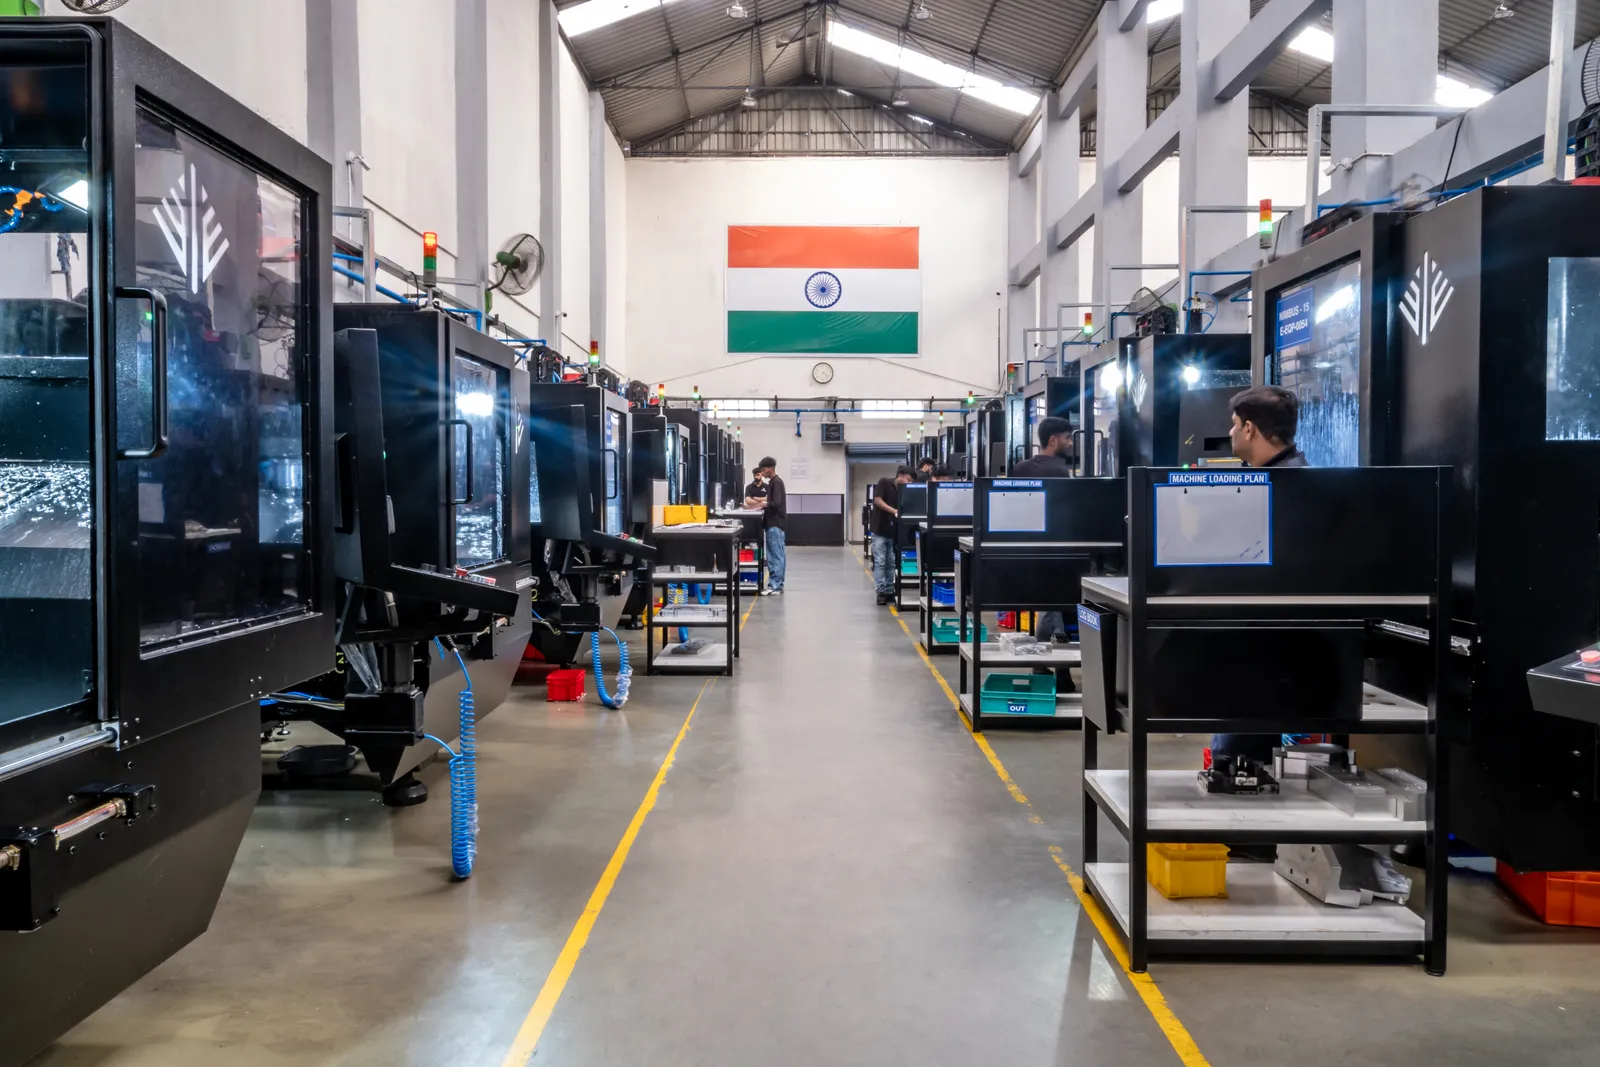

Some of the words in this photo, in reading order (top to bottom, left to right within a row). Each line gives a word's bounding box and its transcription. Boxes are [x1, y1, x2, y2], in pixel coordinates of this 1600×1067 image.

[1279, 305, 1299, 321] NIMBUS
[1303, 302, 1310, 312] 15
[1172, 475, 1207, 483] MACHINE
[1209, 475, 1242, 483] LOADING
[1244, 475, 1265, 483] PLAN
[1087, 612, 1098, 626] BOOK
